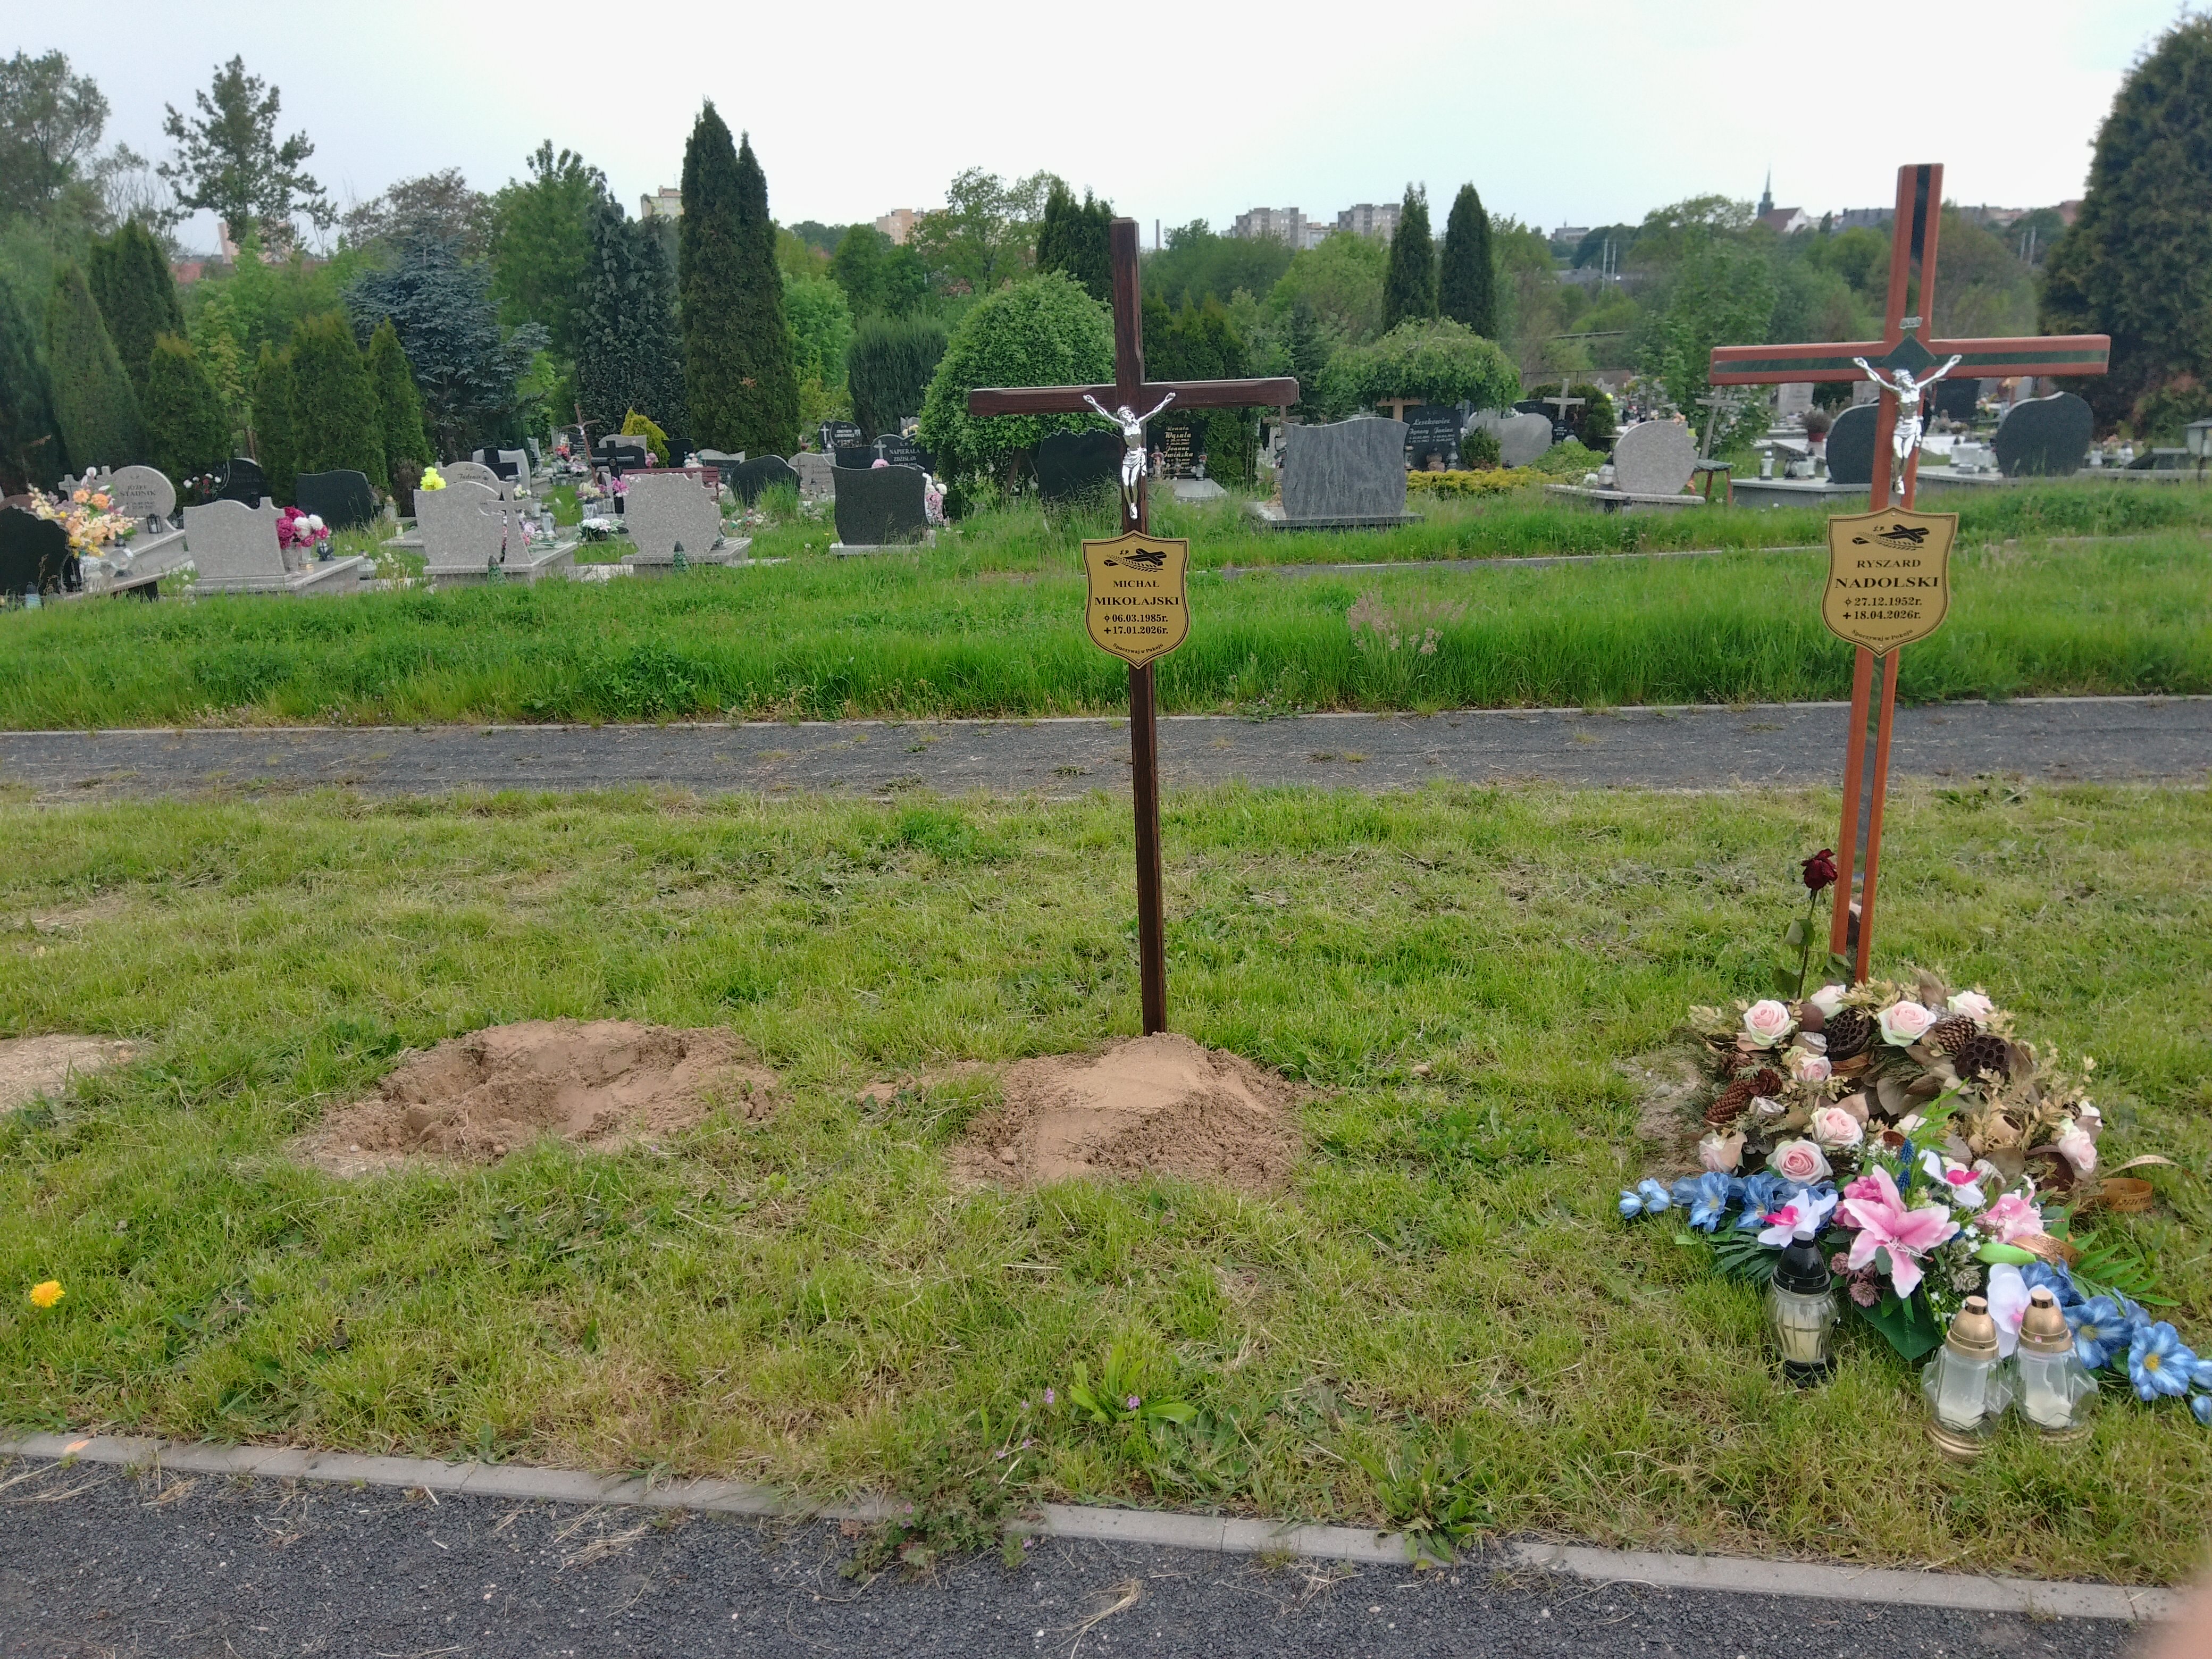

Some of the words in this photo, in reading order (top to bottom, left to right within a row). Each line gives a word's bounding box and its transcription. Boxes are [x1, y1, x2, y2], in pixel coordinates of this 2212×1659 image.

[1857, 559, 1921, 568] RYSZARD
[1835, 576, 1940, 588] NADOLSKI
[1094, 597, 1179, 606] MIKOŁAJSKI
[1854, 597, 1923, 606] 27.12.1952r.
[1854, 610, 1922, 619] 18.04.2026r.
[1113, 626, 1169, 634] 17.01.2026r.
[1112, 642, 1140, 655] Spoczywaj
[1146, 643, 1163, 653] Pokoju
